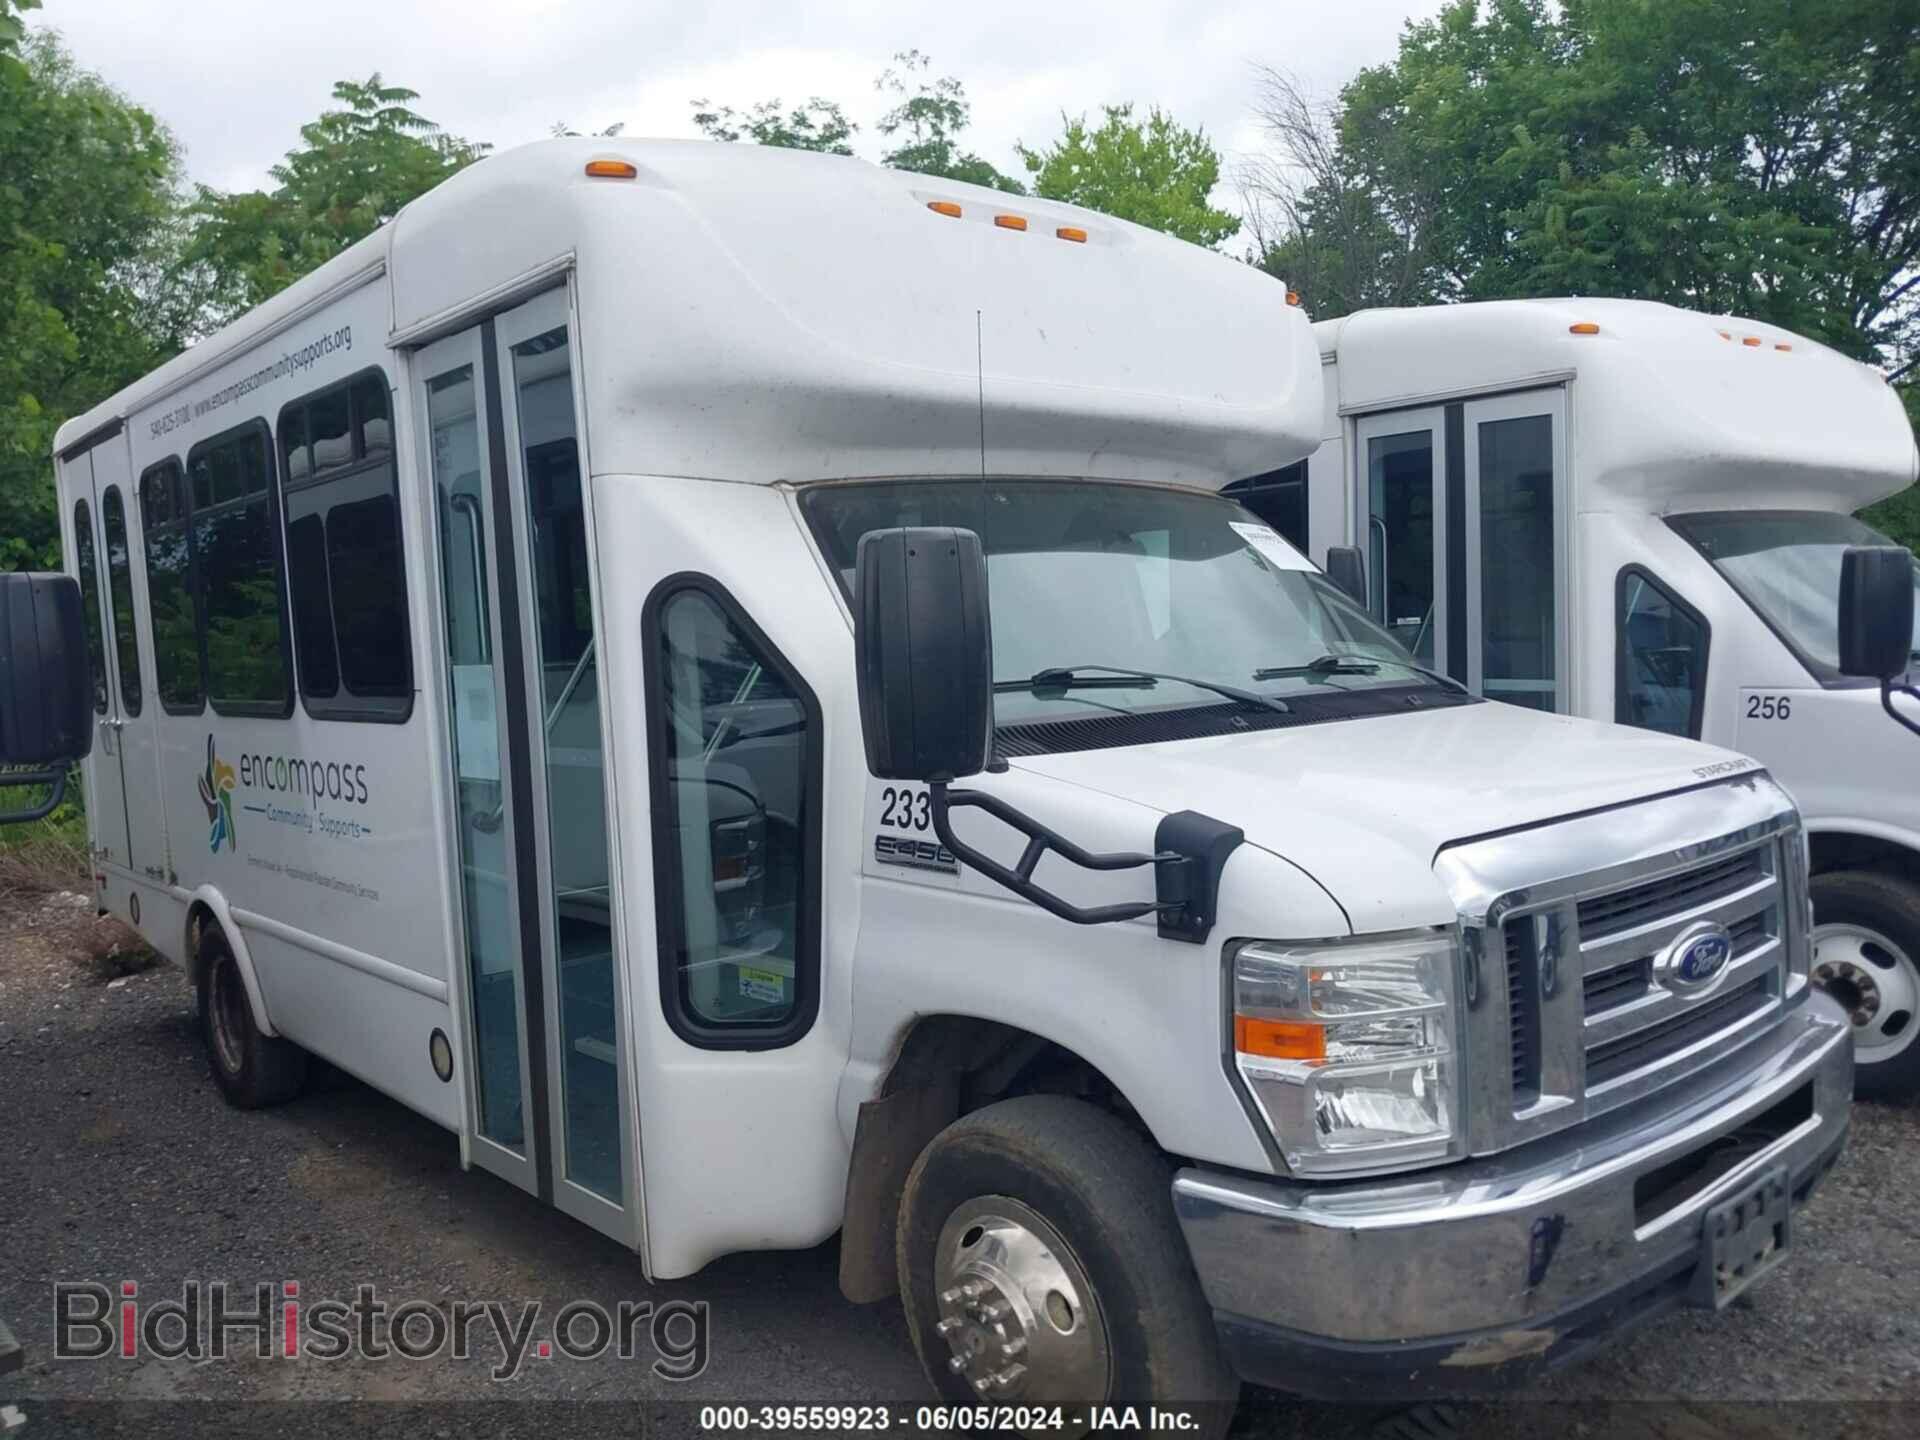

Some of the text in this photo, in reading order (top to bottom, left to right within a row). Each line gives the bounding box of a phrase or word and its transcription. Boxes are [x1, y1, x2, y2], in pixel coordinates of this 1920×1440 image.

[1747, 695, 1791, 720] 256
[240, 753, 368, 810] encompass
[265, 802, 361, 838] Community Supports
[881, 787, 930, 831] 233
[1691, 942, 1723, 977] Ford
